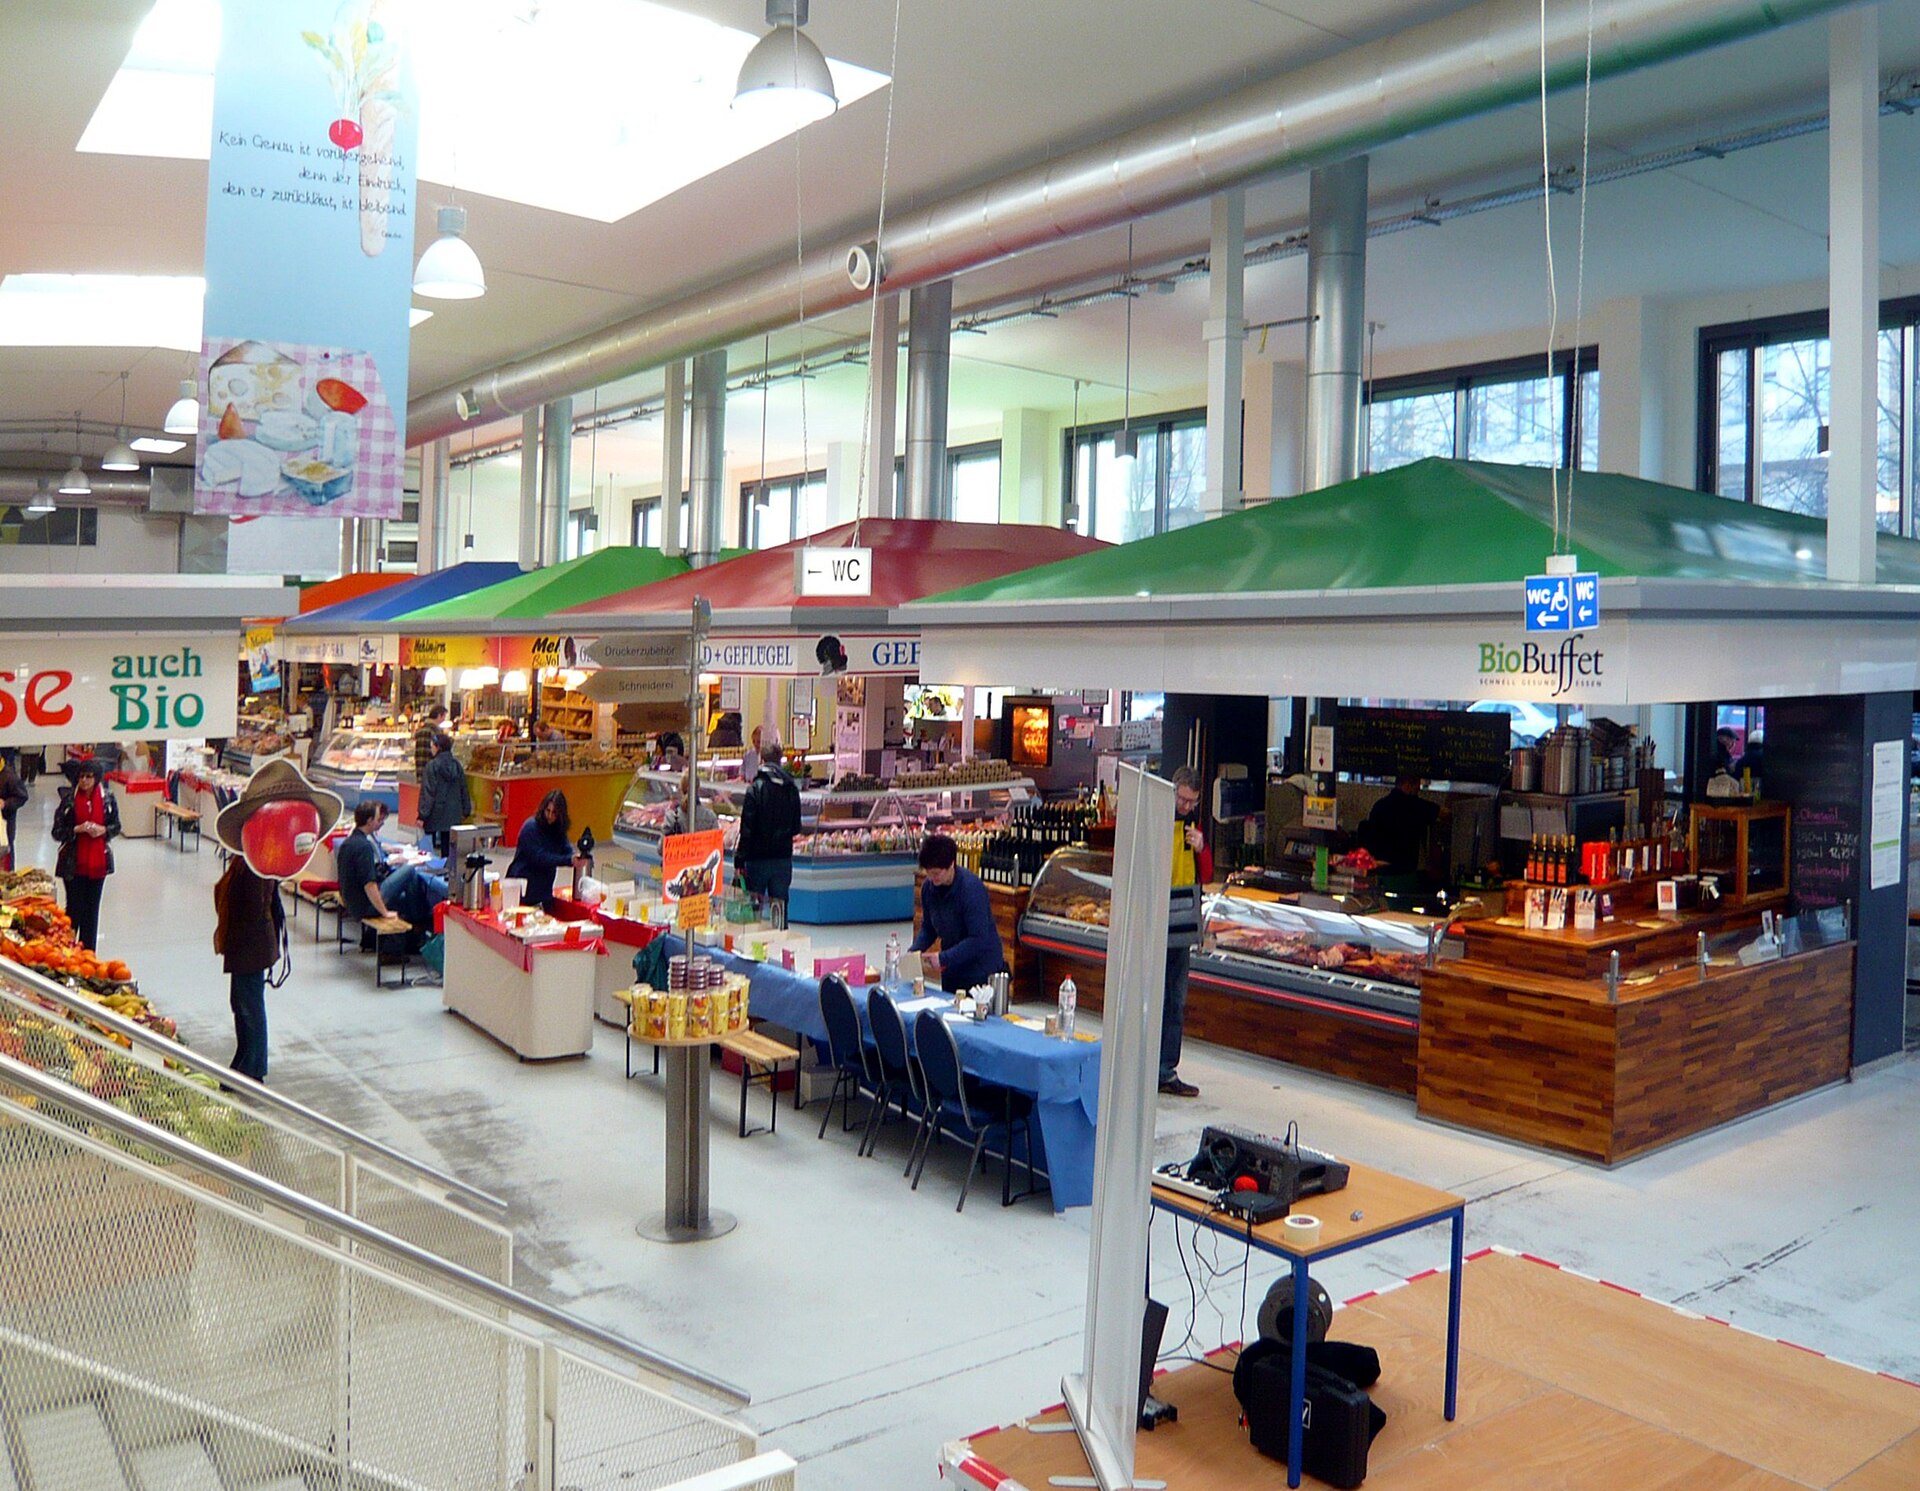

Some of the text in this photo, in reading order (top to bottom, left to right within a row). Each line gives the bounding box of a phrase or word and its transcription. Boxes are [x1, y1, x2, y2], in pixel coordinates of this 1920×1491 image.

[219, 131, 247, 147] Kein
[252, 134, 294, 154] Genuss
[299, 144, 311, 156] ist
[298, 166, 327, 182] denn
[332, 171, 351, 186] der
[222, 182, 245, 197] den
[250, 187, 265, 197] er
[341, 196, 353, 210] ist
[832, 558, 860, 582] WC
[1527, 580, 1595, 605] WC WC
[111, 647, 203, 679] auch
[604, 645, 675, 657] Druckerzubehör
[723, 644, 793, 666] GEFLÜGEL
[1478, 633, 1604, 697] BioBuffet
[618, 681, 674, 692] Schneiderei
[1479, 678, 1602, 688] SCHNELL GESUND ESSEN
[109, 684, 205, 731] Bio
